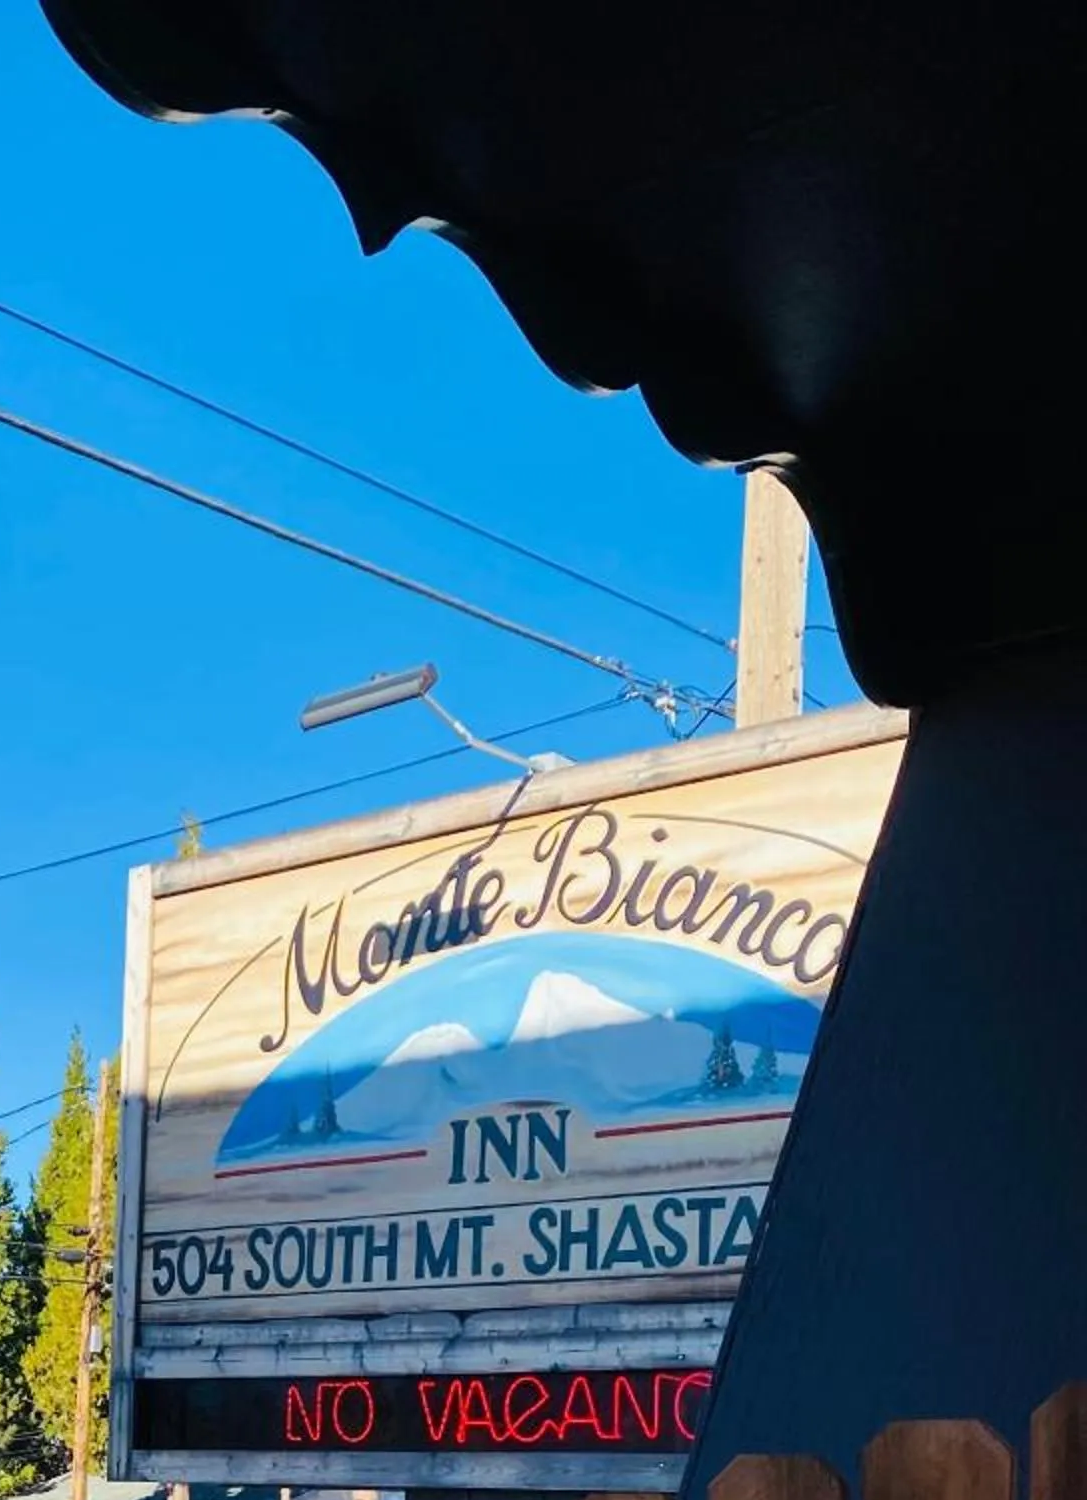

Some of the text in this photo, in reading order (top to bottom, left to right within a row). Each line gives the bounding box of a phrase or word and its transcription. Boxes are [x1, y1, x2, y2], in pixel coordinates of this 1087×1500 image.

[259, 802, 848, 1053] Monte Bianco
[447, 1109, 571, 1184] INN
[152, 1195, 766, 1296] 504 SOUTH MT. SHASTA
[285, 1380, 375, 1443] NO
